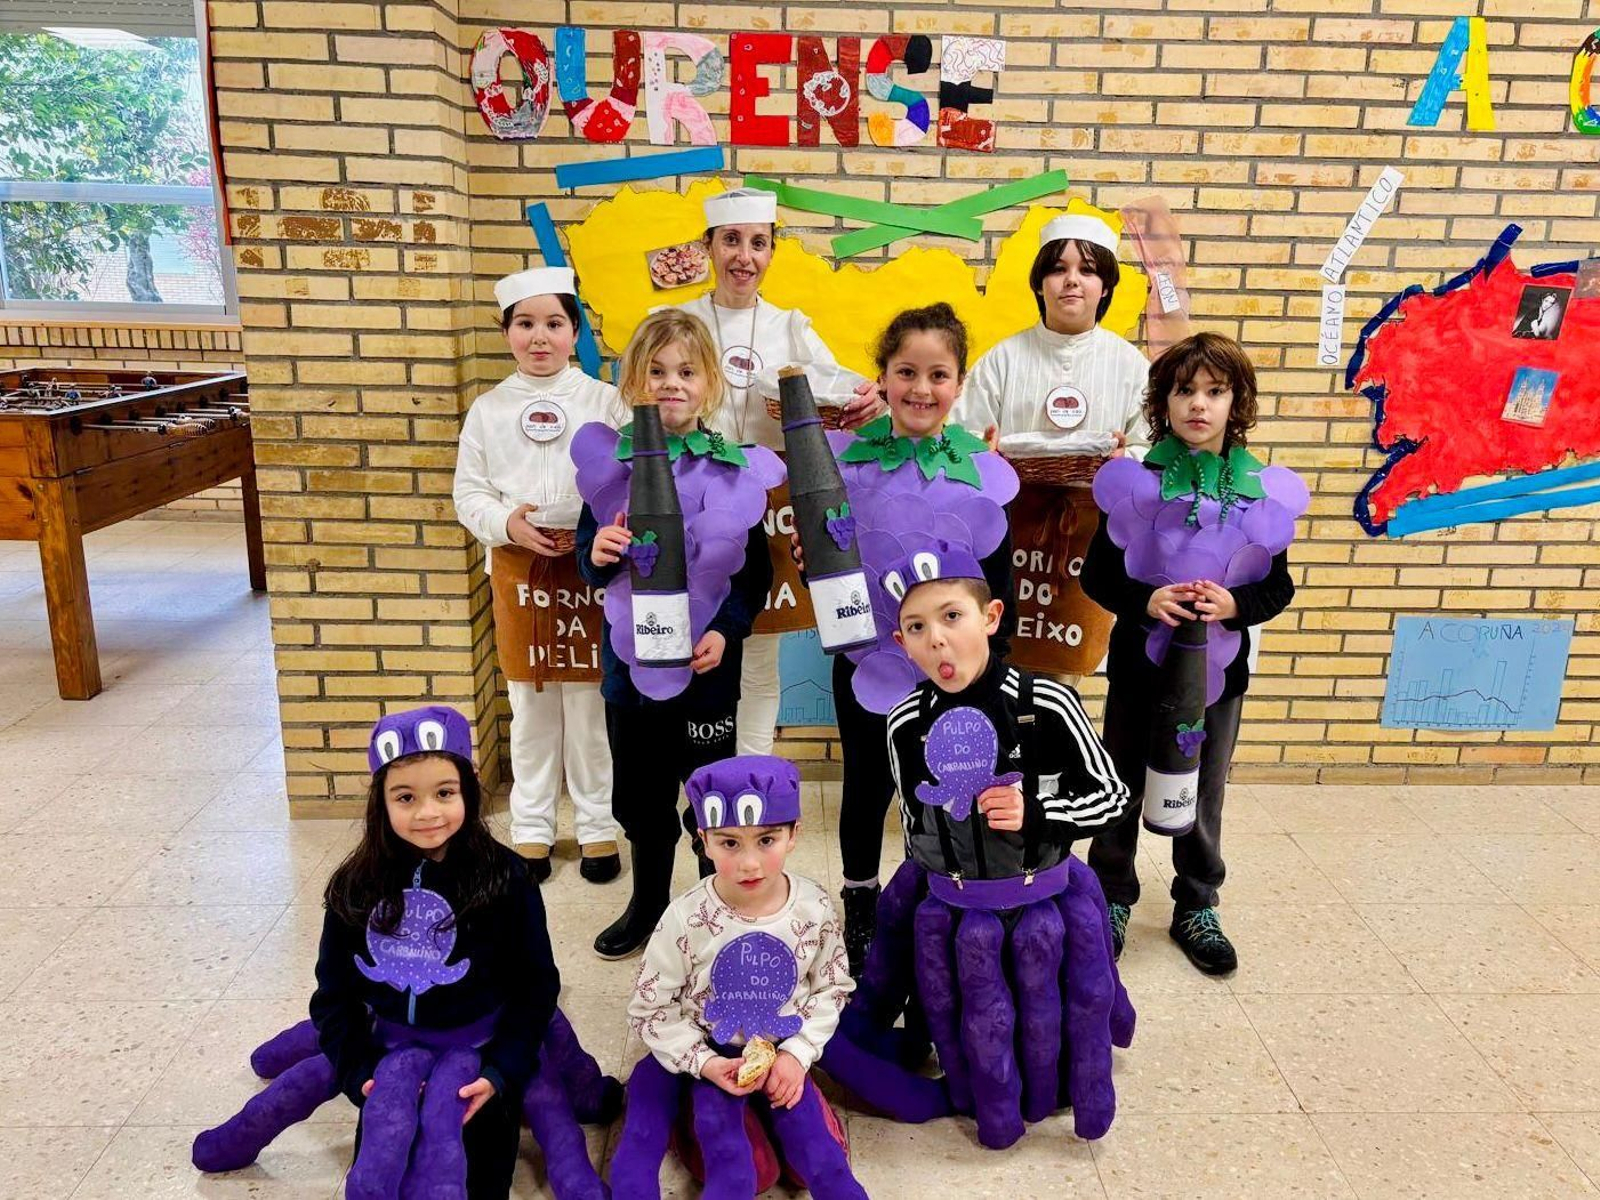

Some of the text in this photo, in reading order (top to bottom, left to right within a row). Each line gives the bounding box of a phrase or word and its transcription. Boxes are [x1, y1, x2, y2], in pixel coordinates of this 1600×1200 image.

[1406, 16, 1496, 131] A
[470, 27, 1006, 152] OURENSE
[1321, 290, 1343, 365] OCÉANO
[635, 623, 674, 636] Ribeiro
[1418, 621, 1434, 640] A
[1440, 622, 1524, 643] CORUÑA
[688, 716, 734, 740] BOSS
[942, 720, 982, 735] PULPO
[953, 743, 971, 755] DO
[404, 904, 445, 922] ULPO
[741, 942, 781, 968] PULPO
[750, 975, 770, 986] DO
